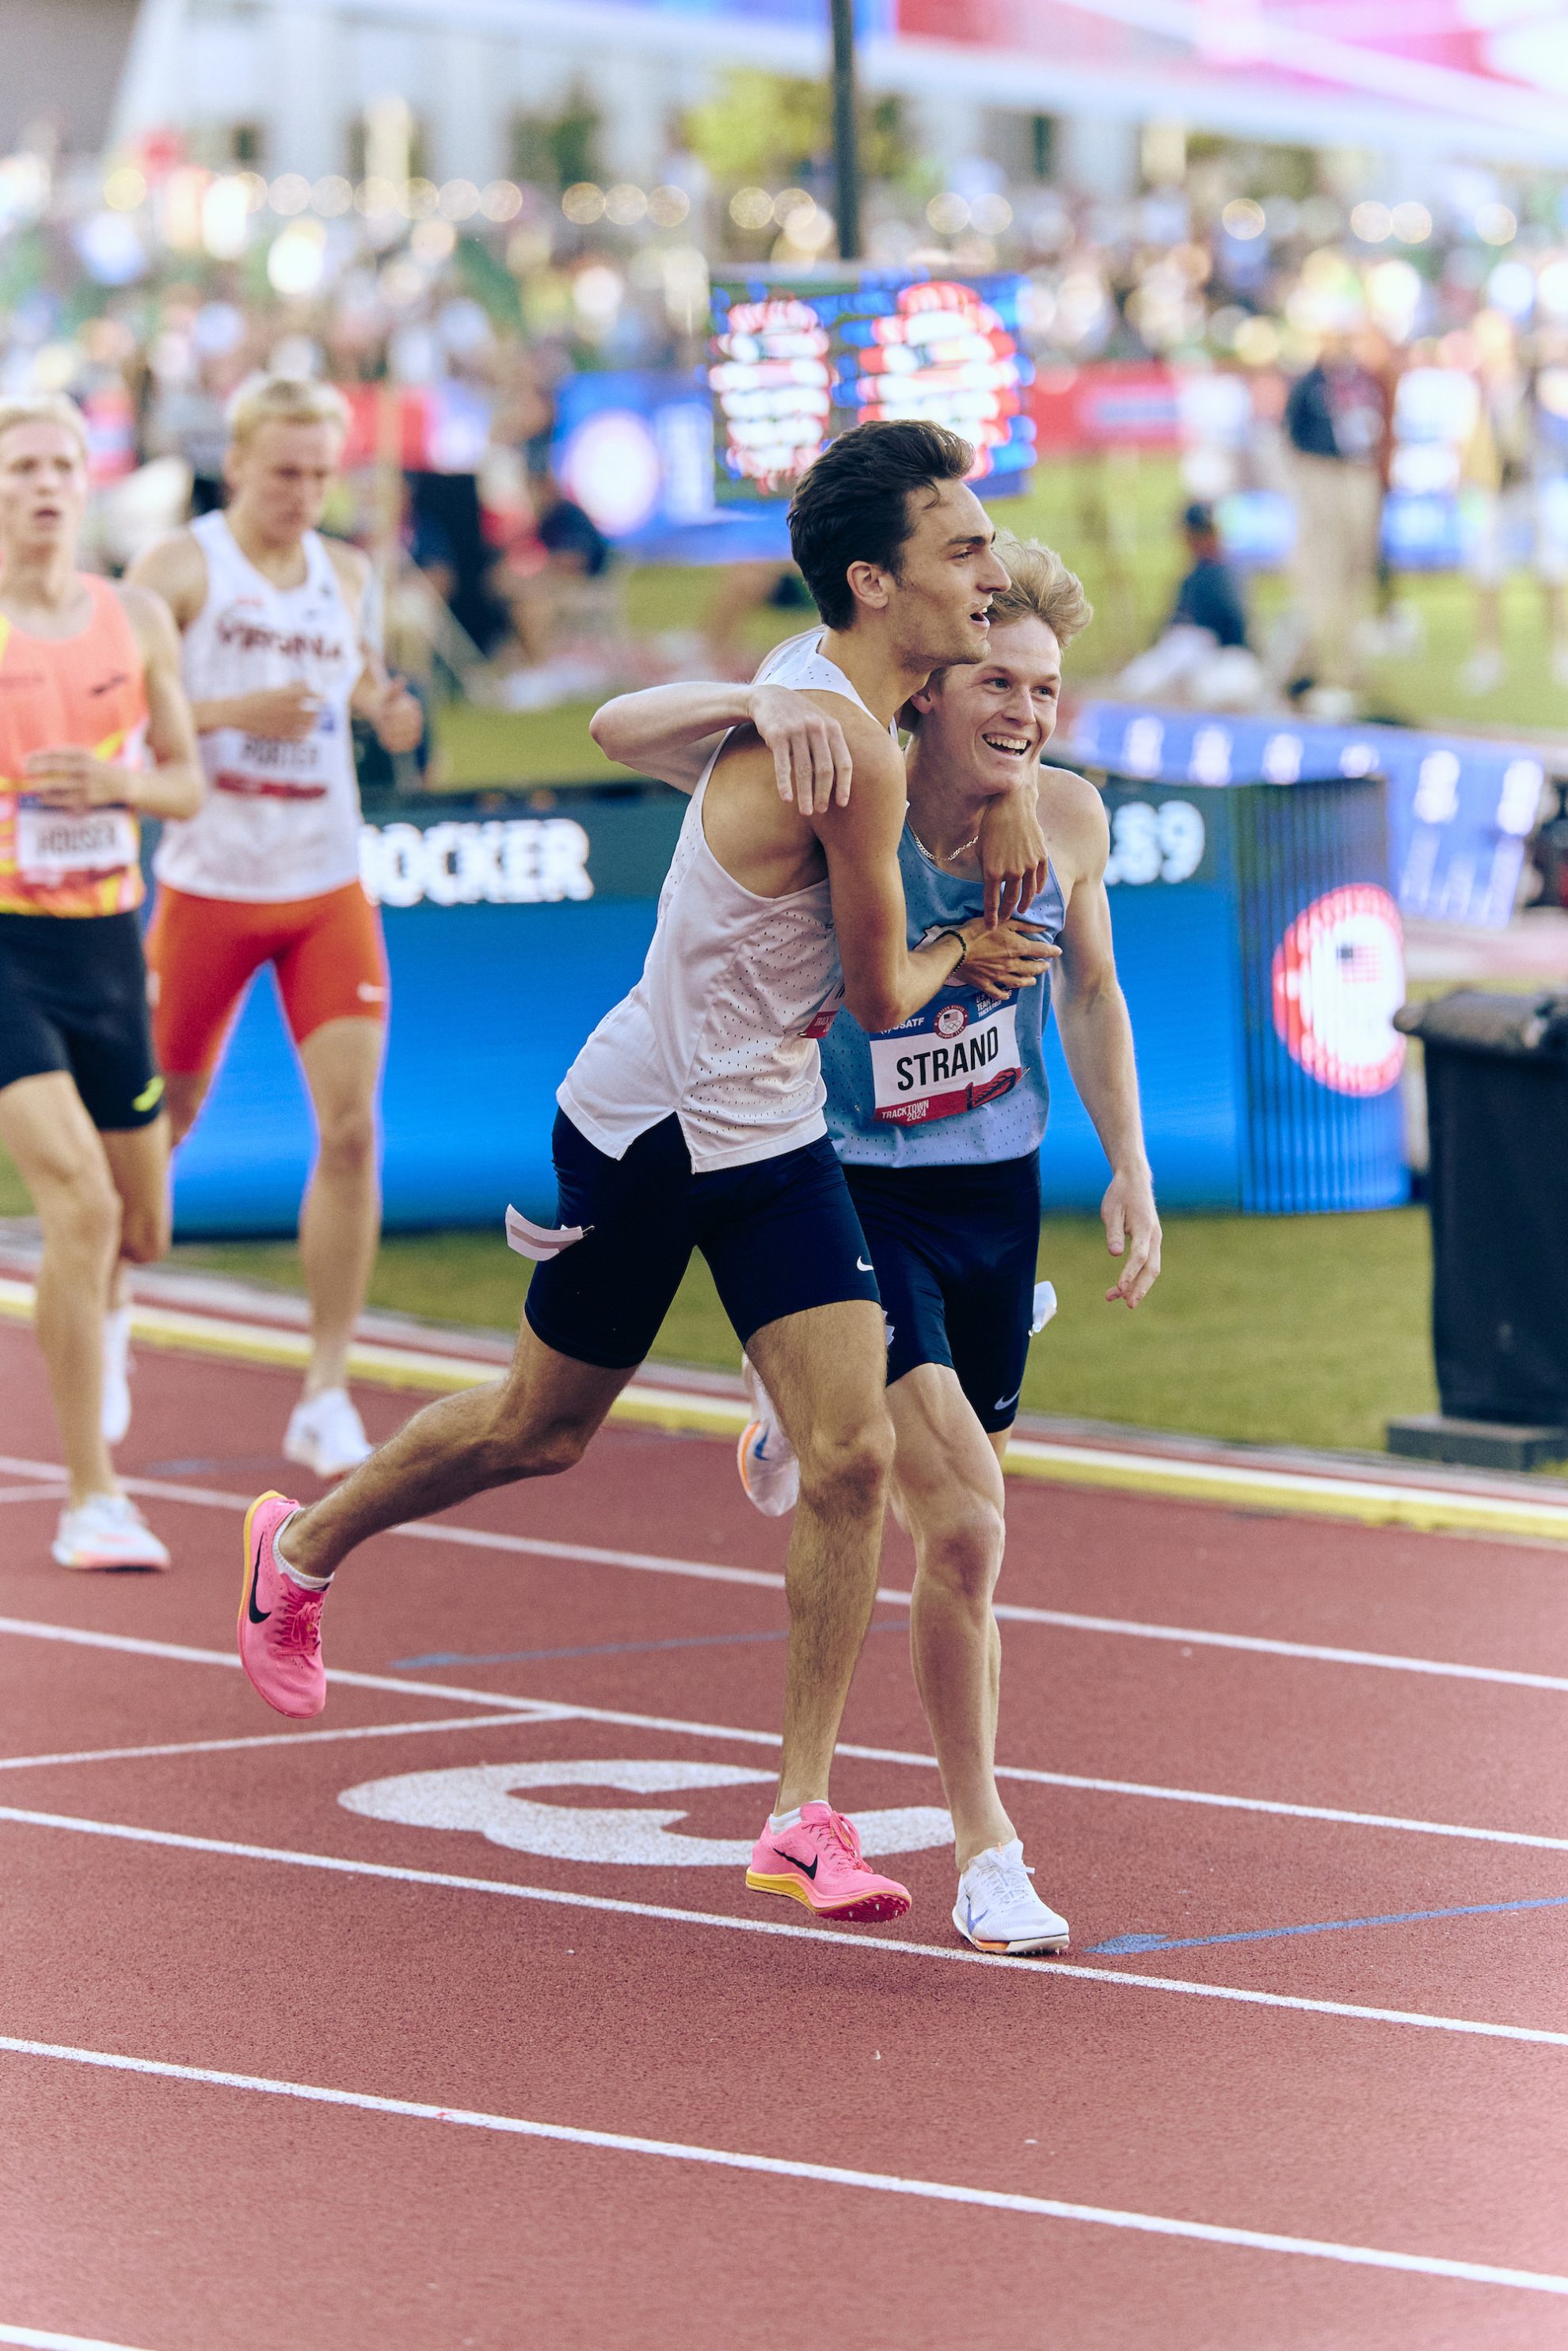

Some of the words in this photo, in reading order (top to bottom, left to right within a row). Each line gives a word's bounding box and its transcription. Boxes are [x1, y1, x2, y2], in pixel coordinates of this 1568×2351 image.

[896, 1025, 999, 1092] STRAND
[881, 1100, 930, 1120] TRACKTOWN
[906, 1109, 927, 1122] 2024
